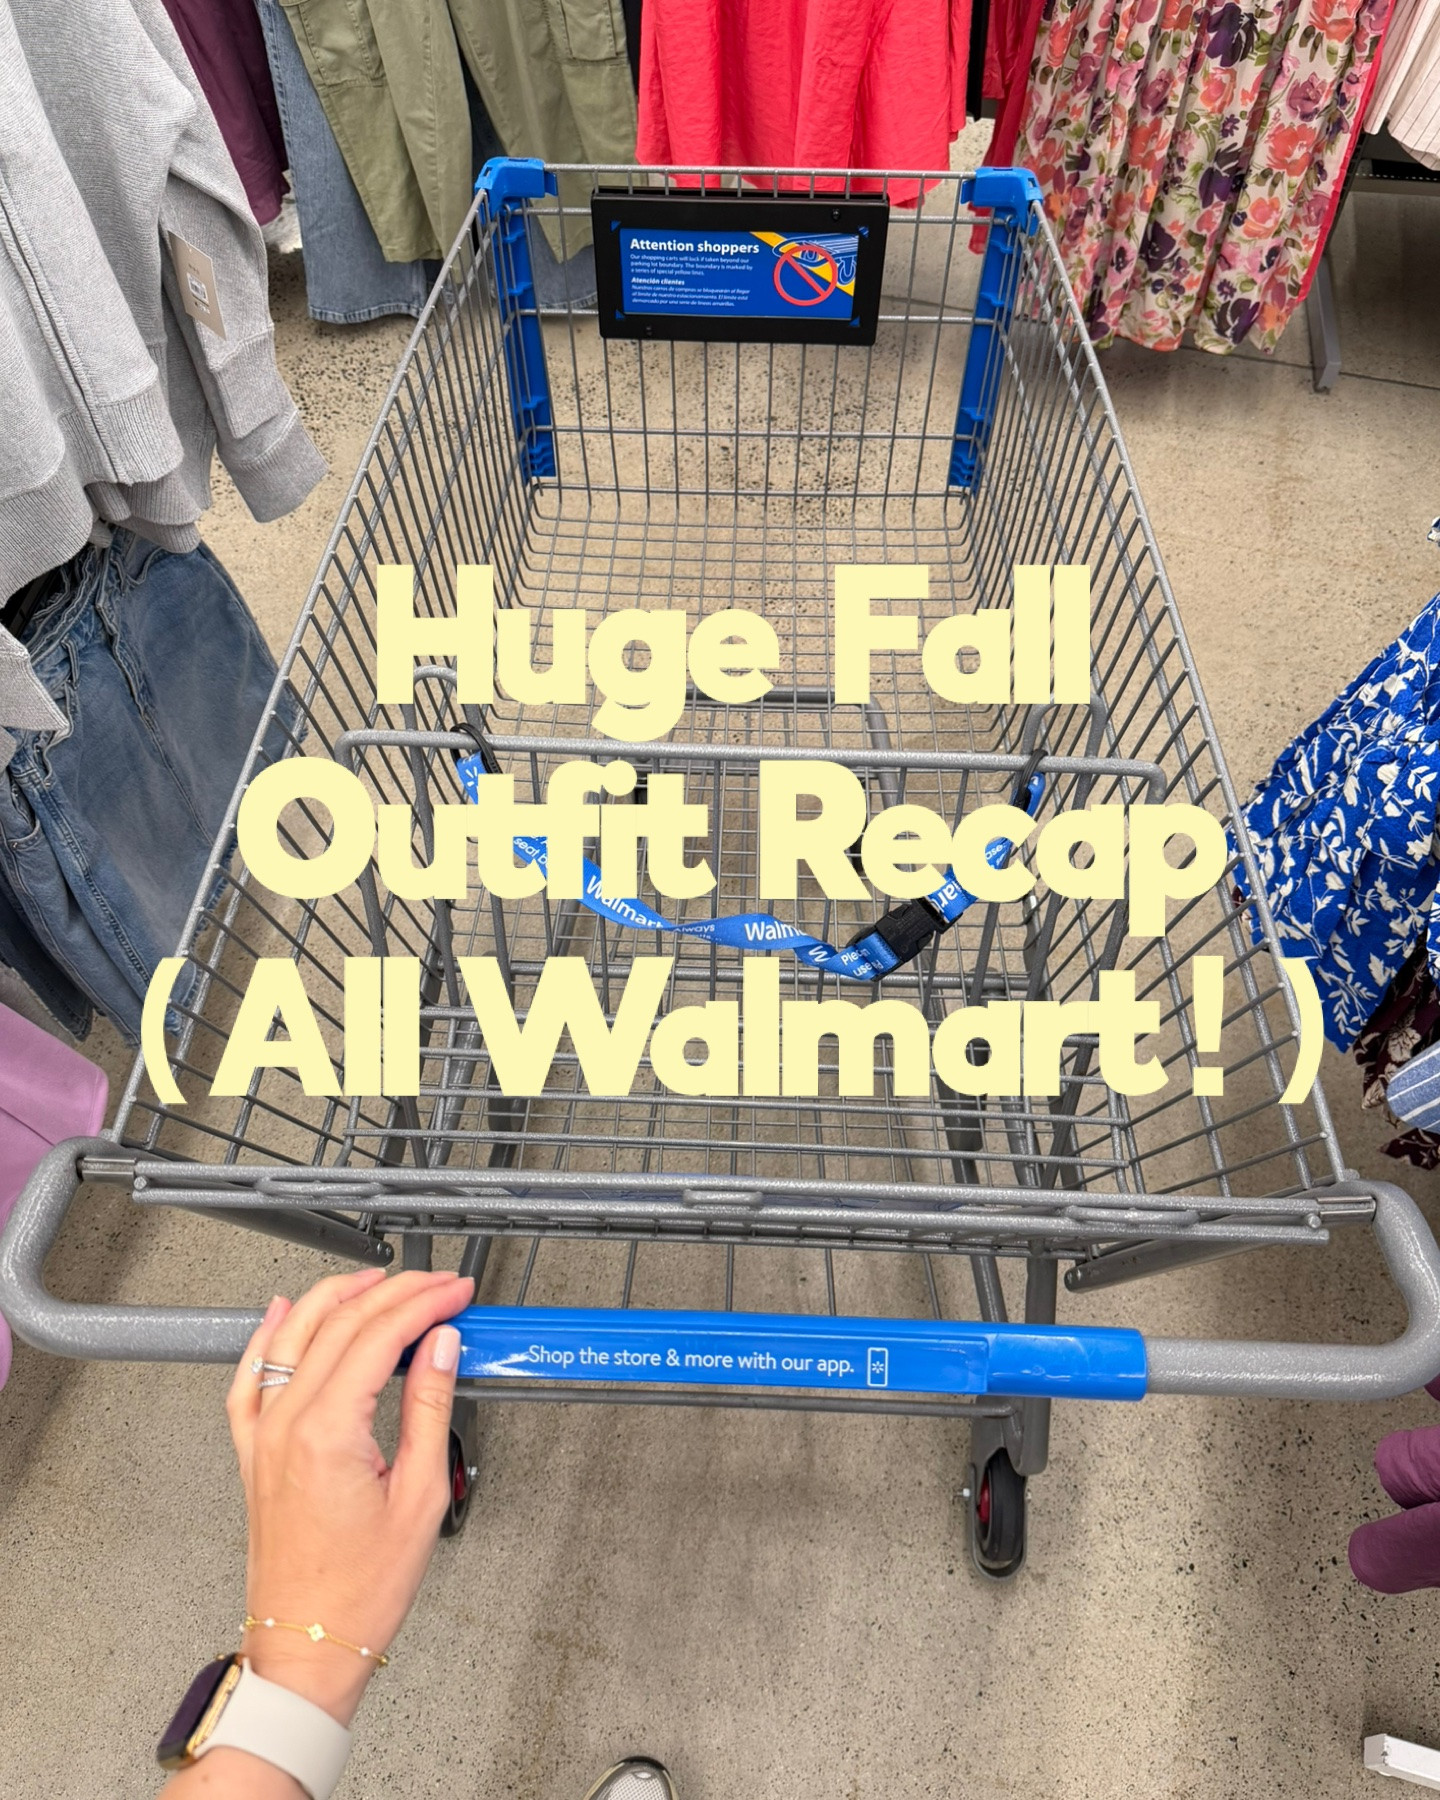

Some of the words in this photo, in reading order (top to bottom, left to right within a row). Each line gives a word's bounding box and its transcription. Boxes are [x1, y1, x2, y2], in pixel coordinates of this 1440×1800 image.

[630, 238, 694, 251] Attention
[697, 240, 760, 256] shoppers
[631, 277, 660, 285] Atención
[660, 278, 685, 286] clientes
[513, 838, 540, 857] seat
[853, 962, 873, 977] use
[529, 1344, 575, 1369] Shop
[579, 1346, 609, 1365] the
[613, 1349, 662, 1366] store
[666, 1348, 680, 1367] &
[684, 1353, 733, 1368] more
[737, 1352, 777, 1370] with
[781, 1357, 814, 1371] our
[816, 1358, 855, 1377] app.
